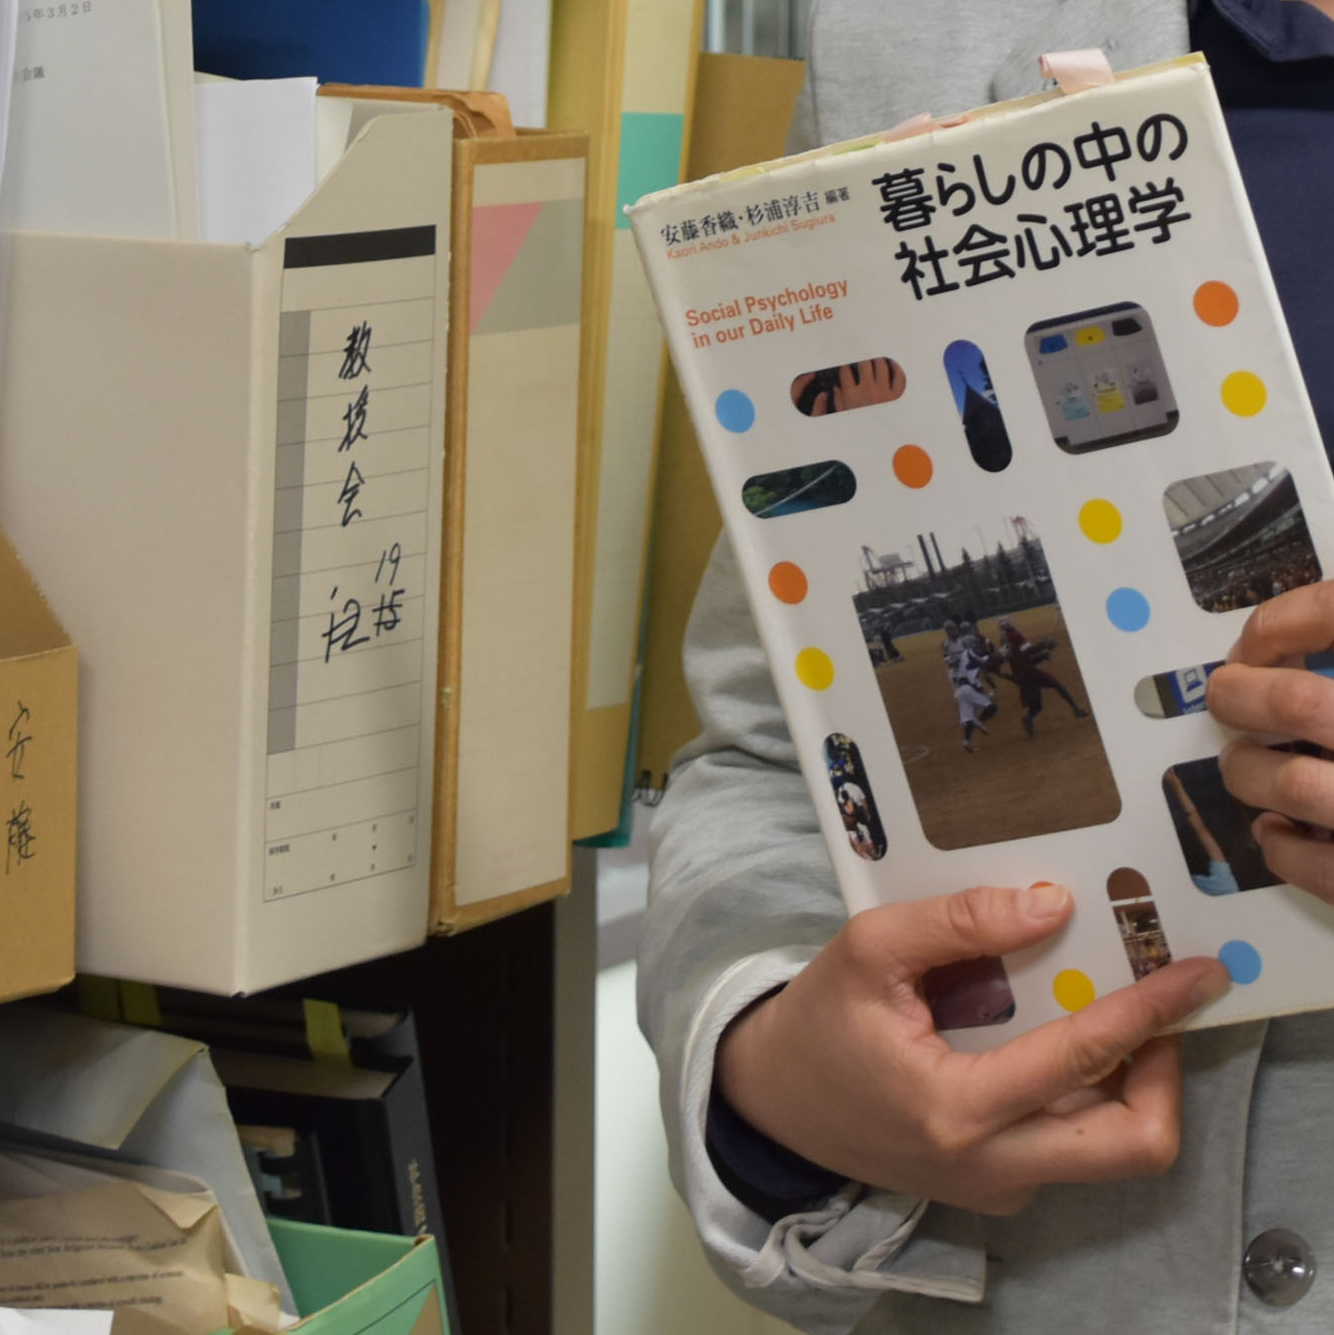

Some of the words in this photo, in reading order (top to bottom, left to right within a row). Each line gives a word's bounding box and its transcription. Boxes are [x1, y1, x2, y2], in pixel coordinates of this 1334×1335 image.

[824, 186, 851, 206] 編著
[871, 112, 1189, 233] 暮らしの中の
[667, 244, 697, 260] Kaori
[699, 236, 729, 253] Ando
[731, 233, 741, 245] &
[744, 221, 791, 243] Junkichi
[791, 213, 836, 233] Sugiura
[894, 176, 1192, 301] 社会心理学
[685, 299, 742, 328] Social
[744, 279, 849, 314] Psychology
[691, 331, 711, 349] in
[715, 325, 746, 344] our
[749, 312, 796, 336] Daily
[799, 303, 834, 325] Life
